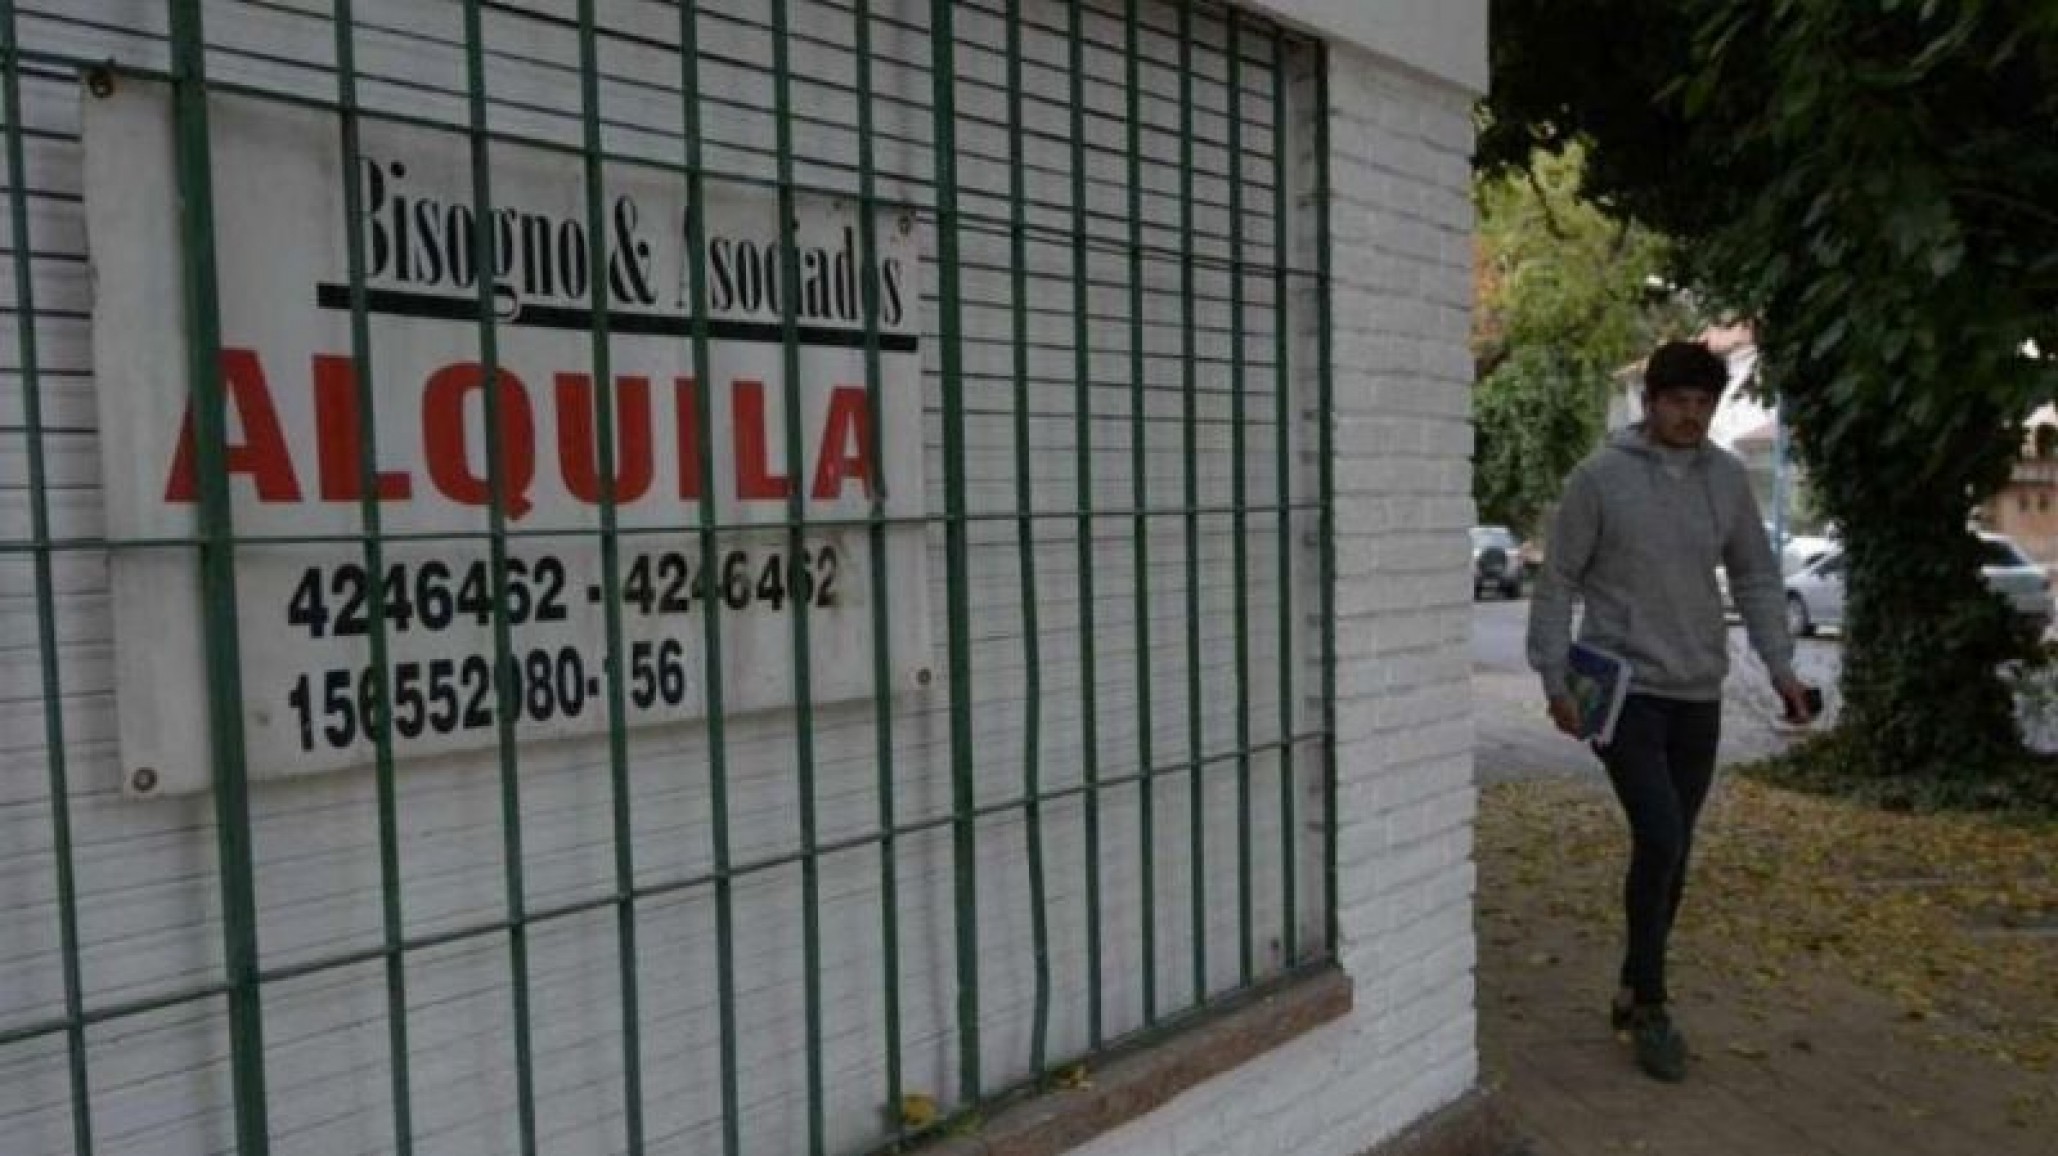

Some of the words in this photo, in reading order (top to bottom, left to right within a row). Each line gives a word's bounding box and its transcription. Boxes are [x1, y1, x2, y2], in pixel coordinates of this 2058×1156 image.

[354, 157, 587, 323] Bisogno
[607, 195, 659, 306] &
[164, 346, 887, 522] ALQUILA
[287, 555, 568, 639] 4246462
